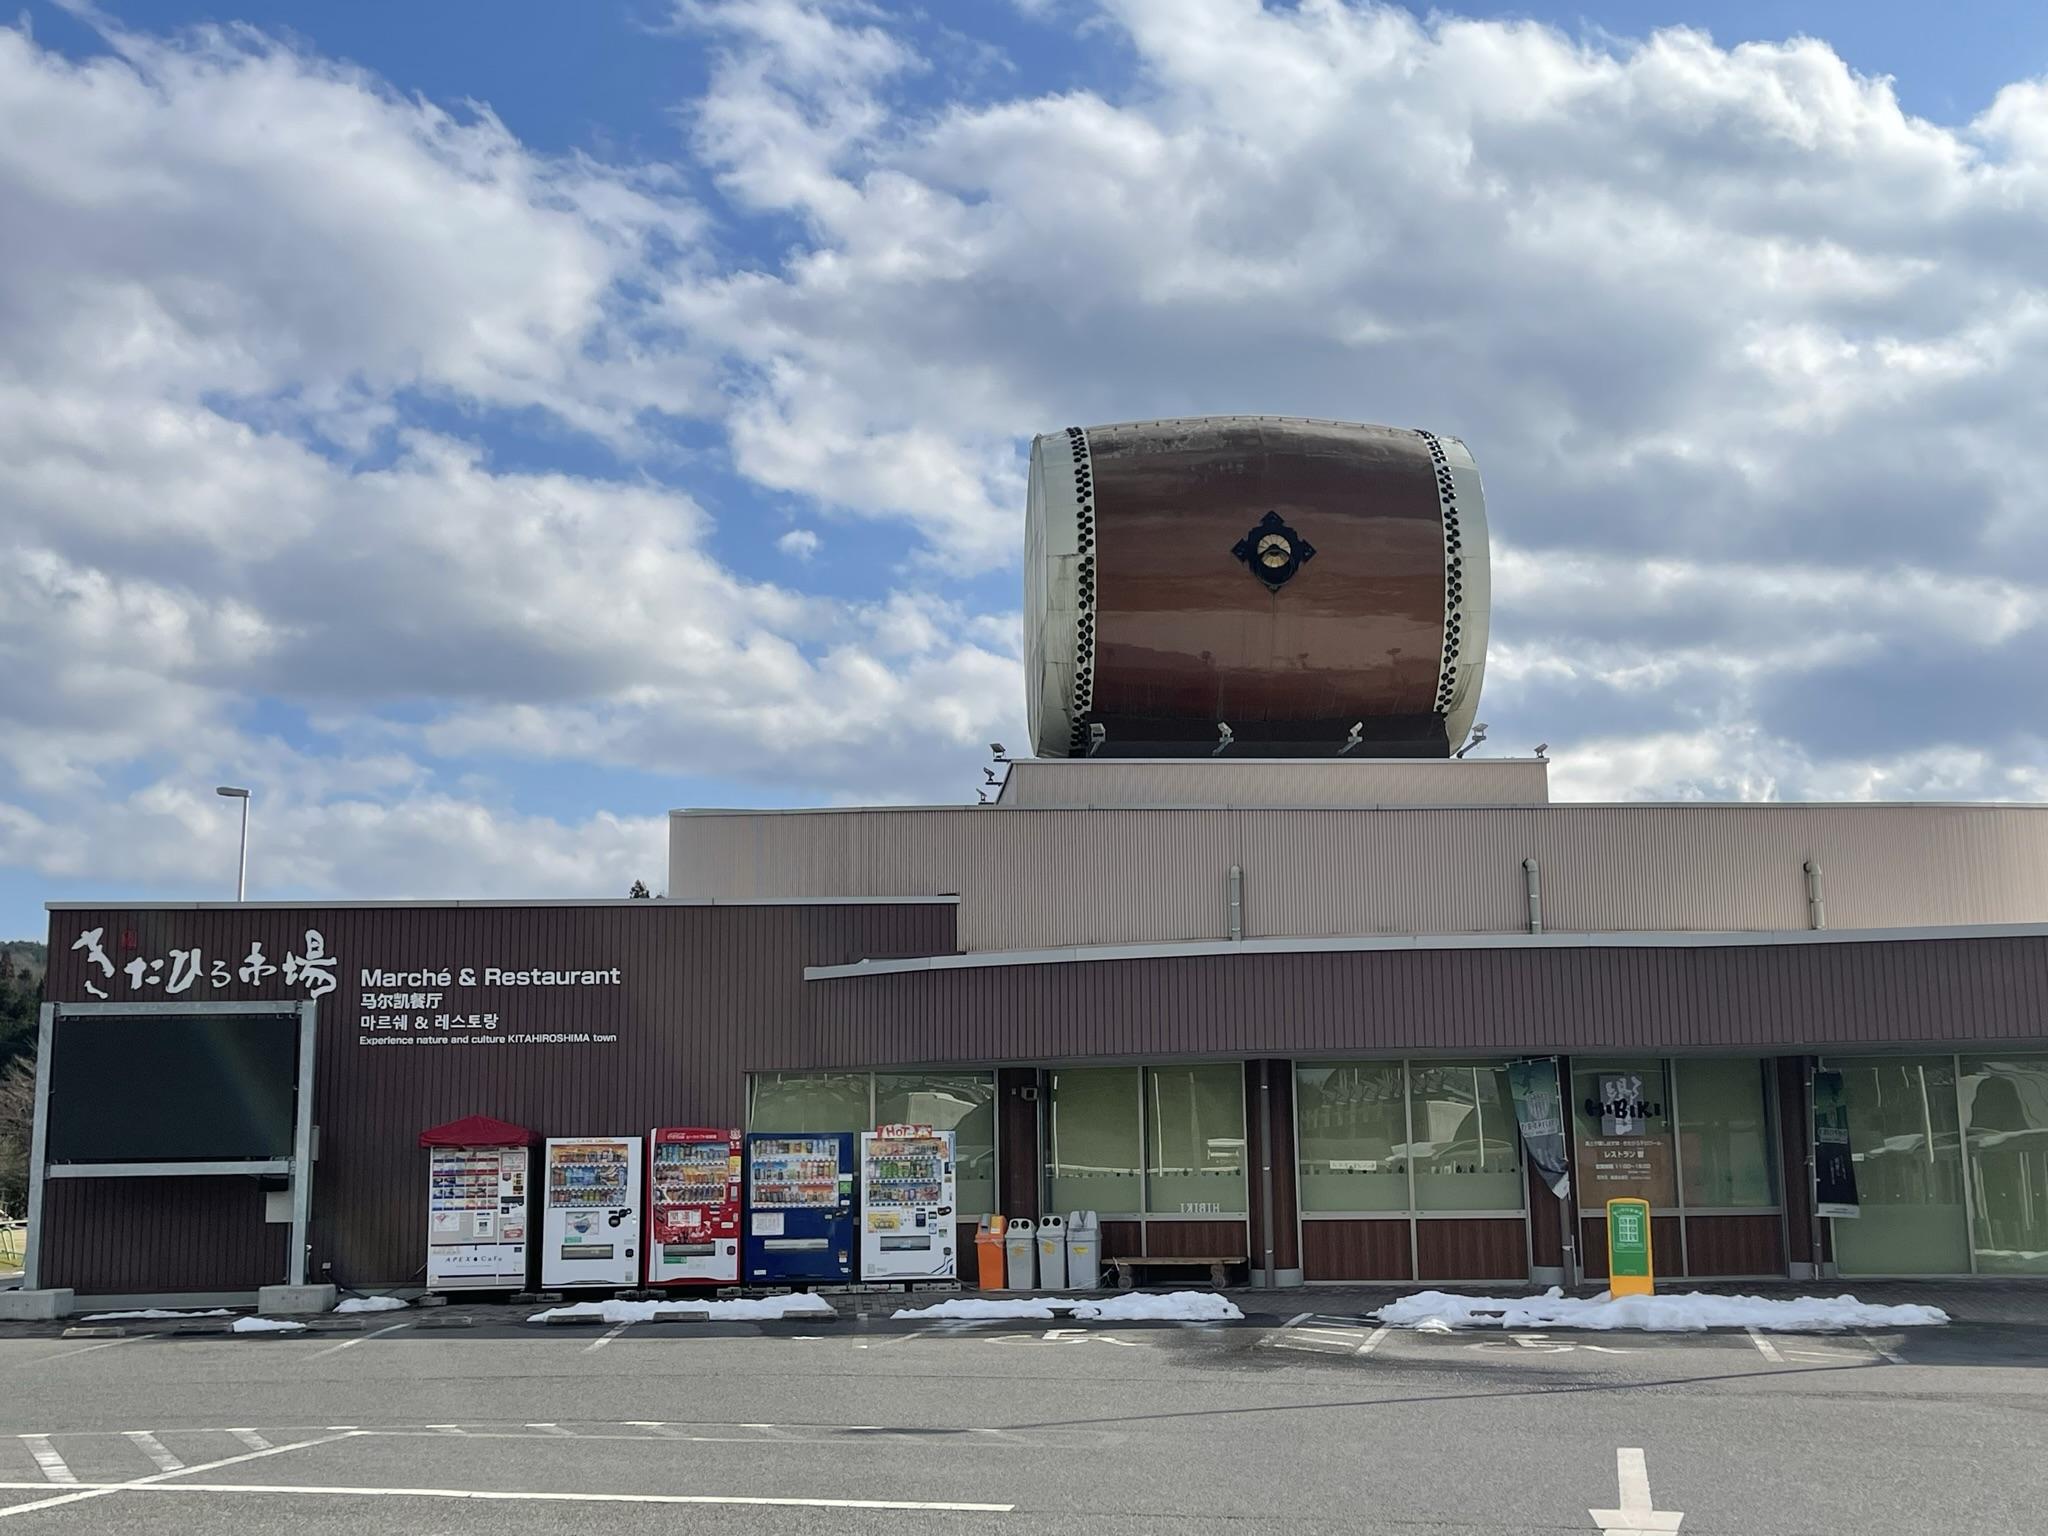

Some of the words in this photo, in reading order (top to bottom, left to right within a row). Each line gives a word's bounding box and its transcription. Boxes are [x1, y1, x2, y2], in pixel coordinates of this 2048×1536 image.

[71, 927, 338, 999] きたひろ市場
[361, 967, 452, 987] Marché
[458, 967, 478, 986] &
[484, 967, 621, 986] Restaurant
[360, 992, 443, 1010] 马尔凯餐厅
[360, 1014, 408, 1031] 마르쉐
[414, 1015, 429, 1030] &
[434, 1013, 499, 1030] 레스토랑
[359, 1035, 414, 1046] Experience
[416, 1036, 449, 1045] nature
[450, 1034, 469, 1044] and
[471, 1034, 506, 1045] culture
[507, 1033, 591, 1044] KITAHIROSHIMA
[592, 1034, 617, 1043] town
[1604, 1150, 1636, 1159] レストラン
